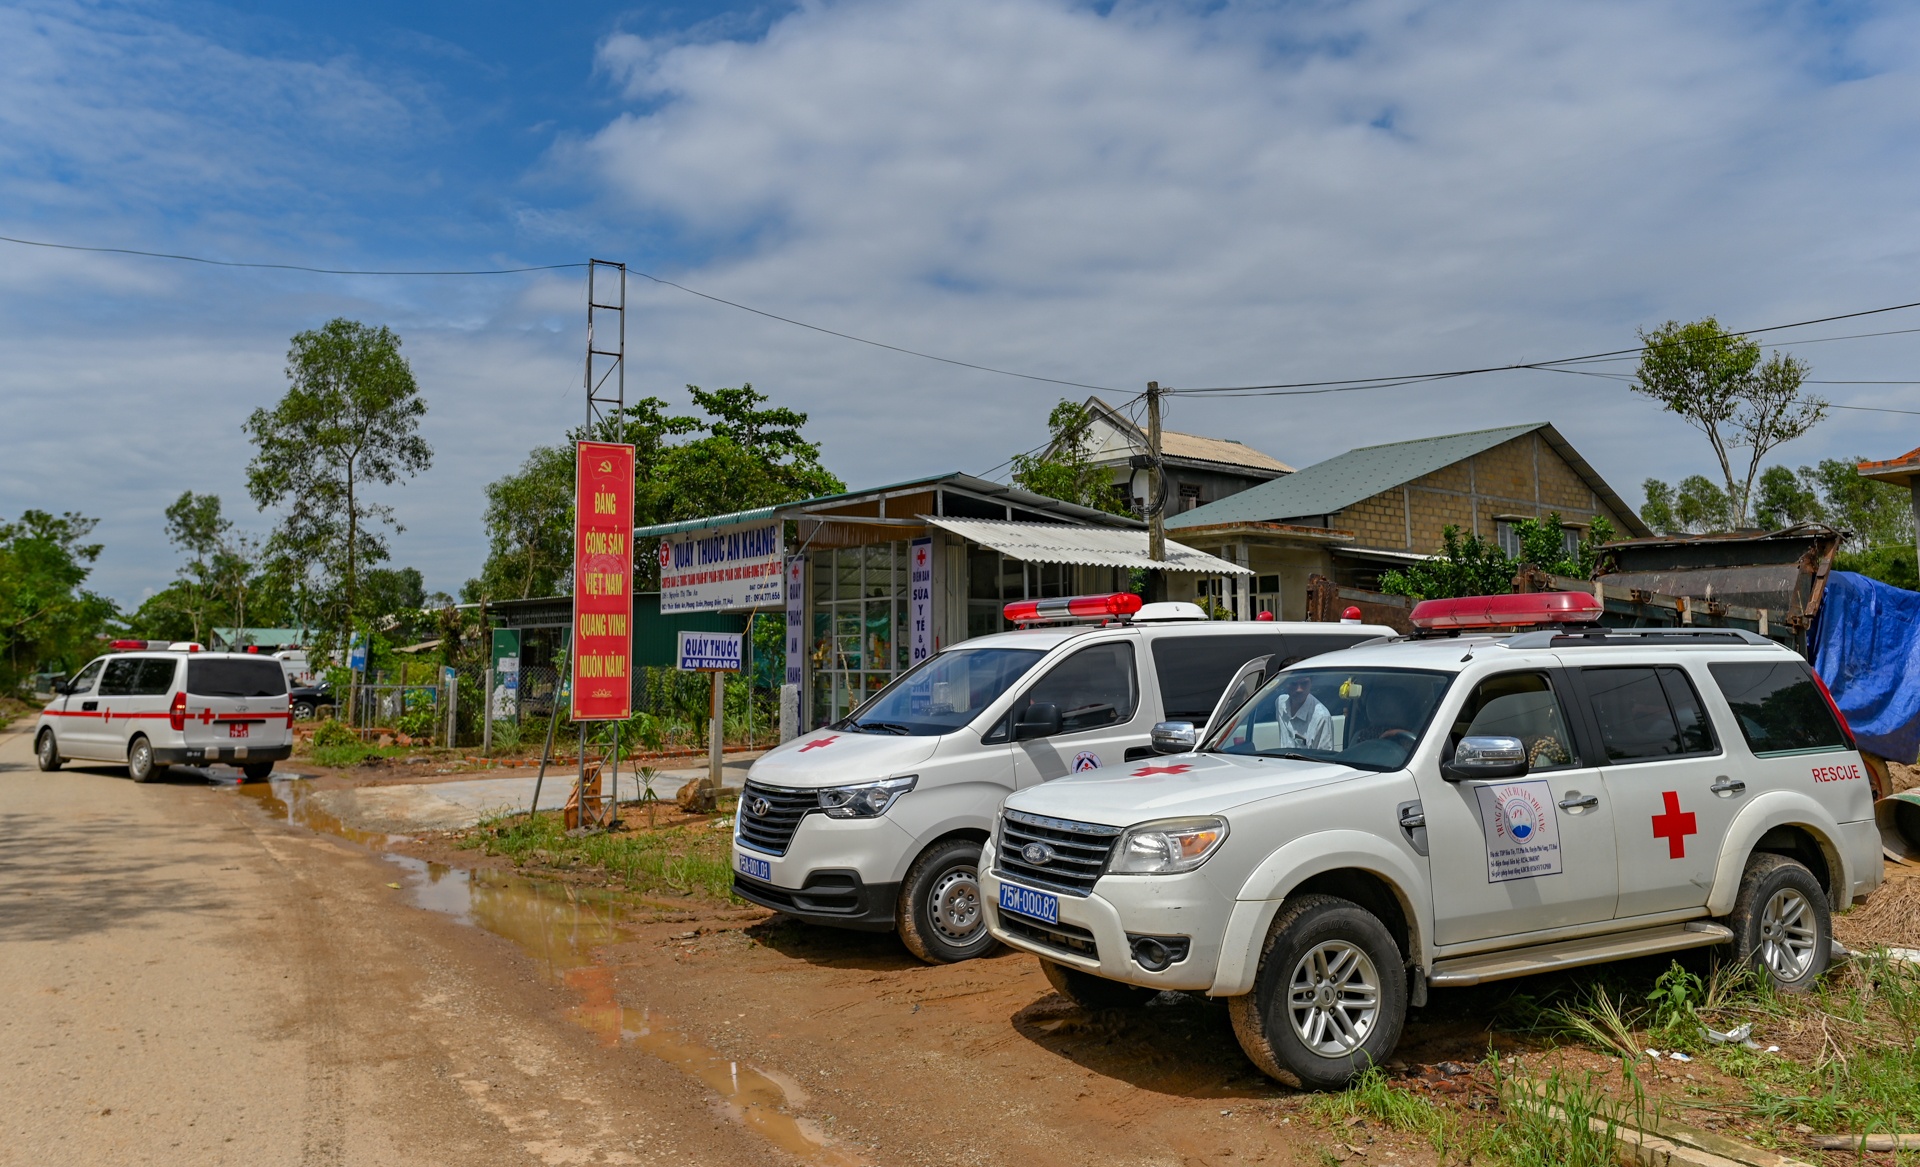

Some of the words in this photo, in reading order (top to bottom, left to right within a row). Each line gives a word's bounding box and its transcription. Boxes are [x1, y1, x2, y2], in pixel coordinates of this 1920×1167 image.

[594, 484, 616, 515] ĐẢNG
[585, 526, 607, 558] CỘNG
[608, 525, 624, 555] SẢN
[727, 532, 740, 561] AN
[742, 526, 776, 558] KHANG
[585, 568, 604, 598] VIỆT
[605, 573, 622, 596] NAM
[918, 604, 924, 616] Y
[580, 614, 606, 640] QUANG
[608, 614, 626, 636] VINH
[916, 616, 925, 632] TẾ
[710, 634, 738, 658] THUỐC
[791, 638, 798, 654] AN
[918, 634, 923, 644] &
[580, 649, 602, 678] MUÔN
[604, 650, 625, 678] NĂM!
[684, 658, 700, 668] AN
[702, 659, 738, 669] KHANG
[787, 667, 800, 684] KHANG
[1812, 764, 1860, 783] RESCUE
